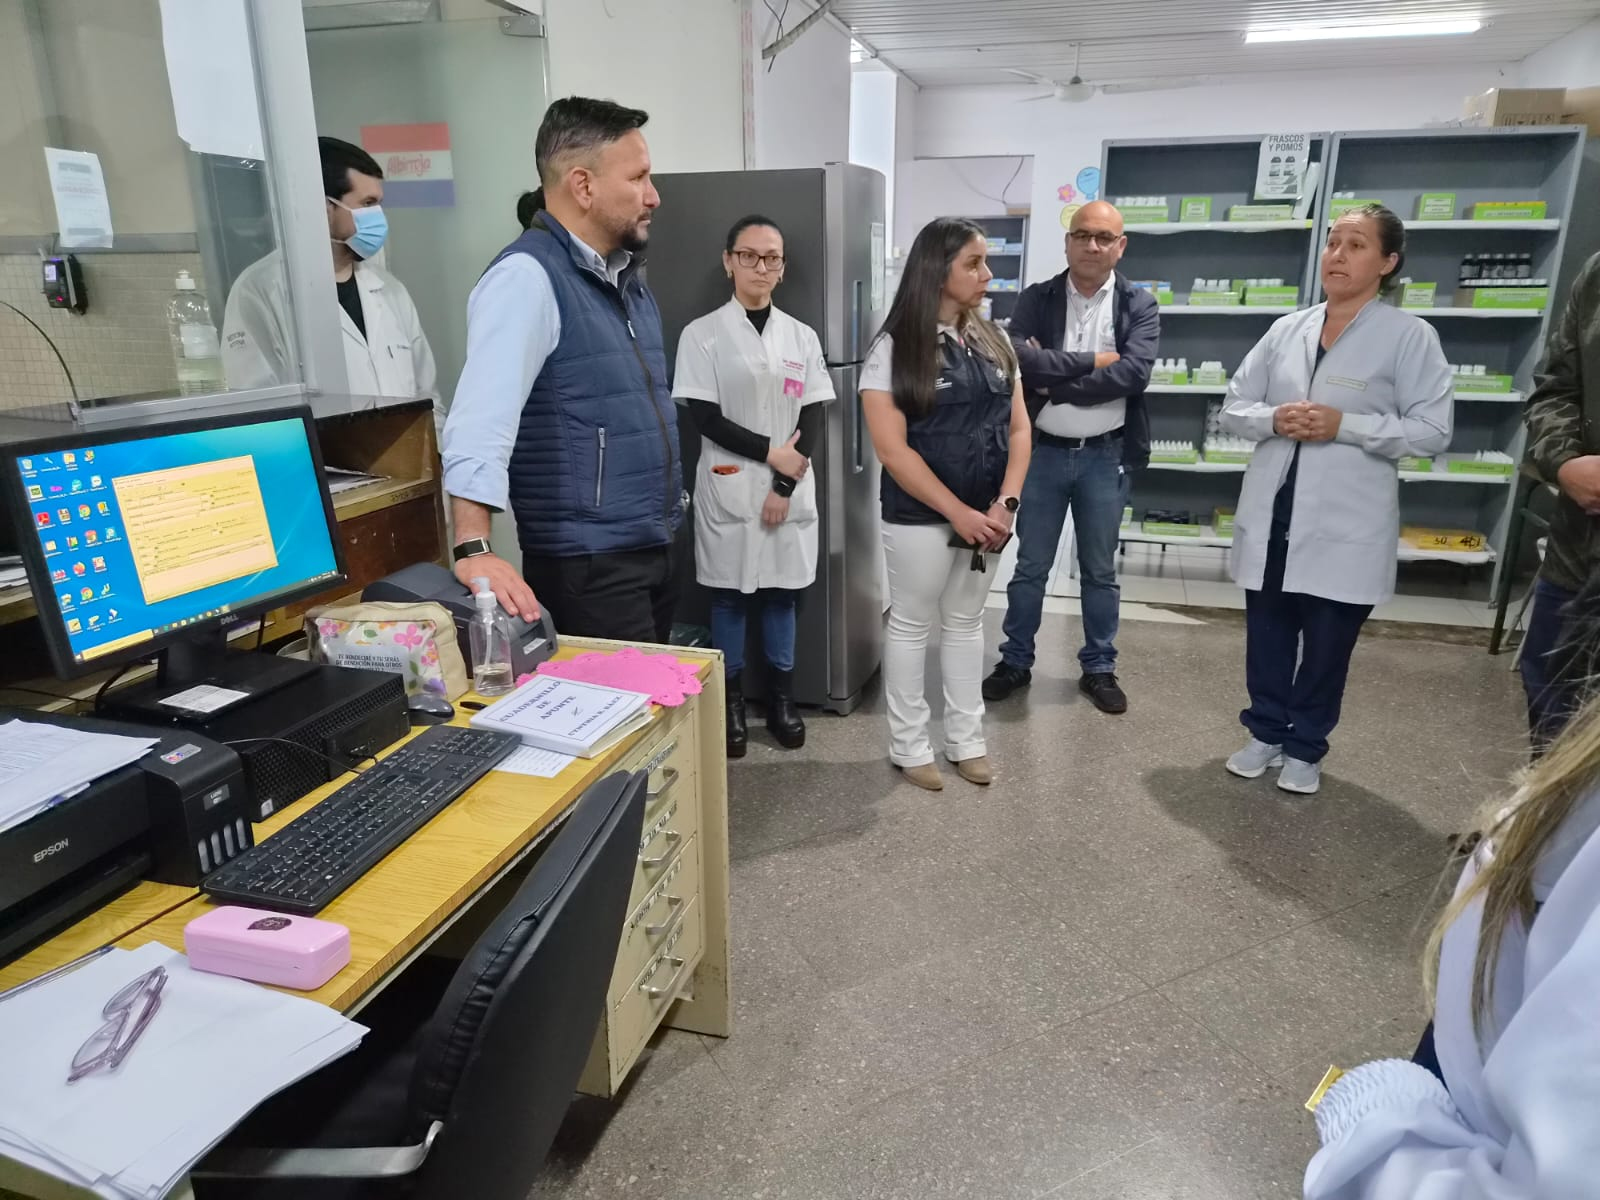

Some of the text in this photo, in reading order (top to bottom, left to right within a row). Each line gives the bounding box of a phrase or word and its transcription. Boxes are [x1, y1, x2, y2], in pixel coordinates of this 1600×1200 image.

[1268, 135, 1305, 143] FRASCOS
[1268, 143, 1304, 152] Y POMOS
[220, 614, 240, 625] DELL
[500, 681, 561, 723] CUADERNILLO
[536, 700, 552, 710] DE
[539, 695, 577, 720] APUNTE
[33, 838, 69, 863] EPSON
